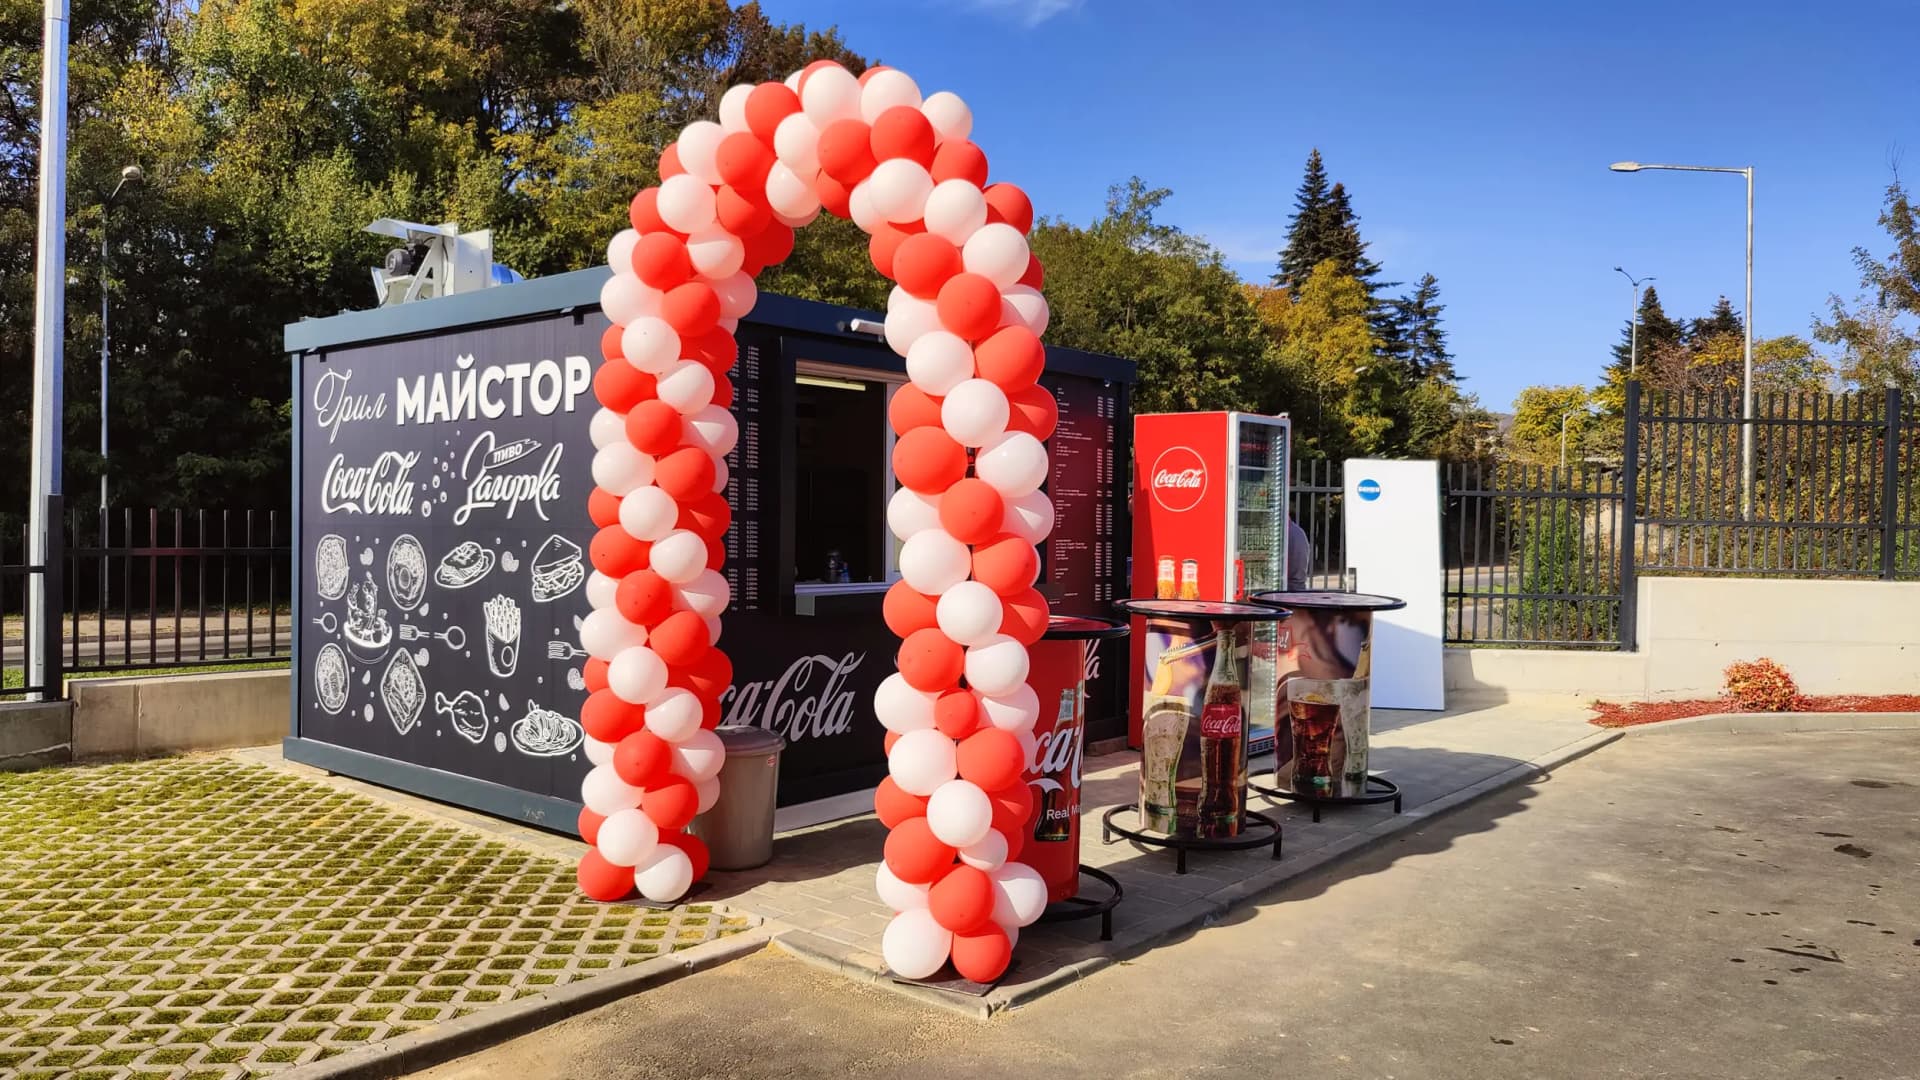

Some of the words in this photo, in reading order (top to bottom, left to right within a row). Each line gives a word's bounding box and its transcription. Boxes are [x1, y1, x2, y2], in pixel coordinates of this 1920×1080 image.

[314, 368, 387, 443] Грил
[396, 353, 592, 425] МАЙСТОР
[322, 450, 421, 515] Coca-Cola
[1154, 468, 1204, 488] Coca-Cola
[1046, 800, 1070, 820] Real
